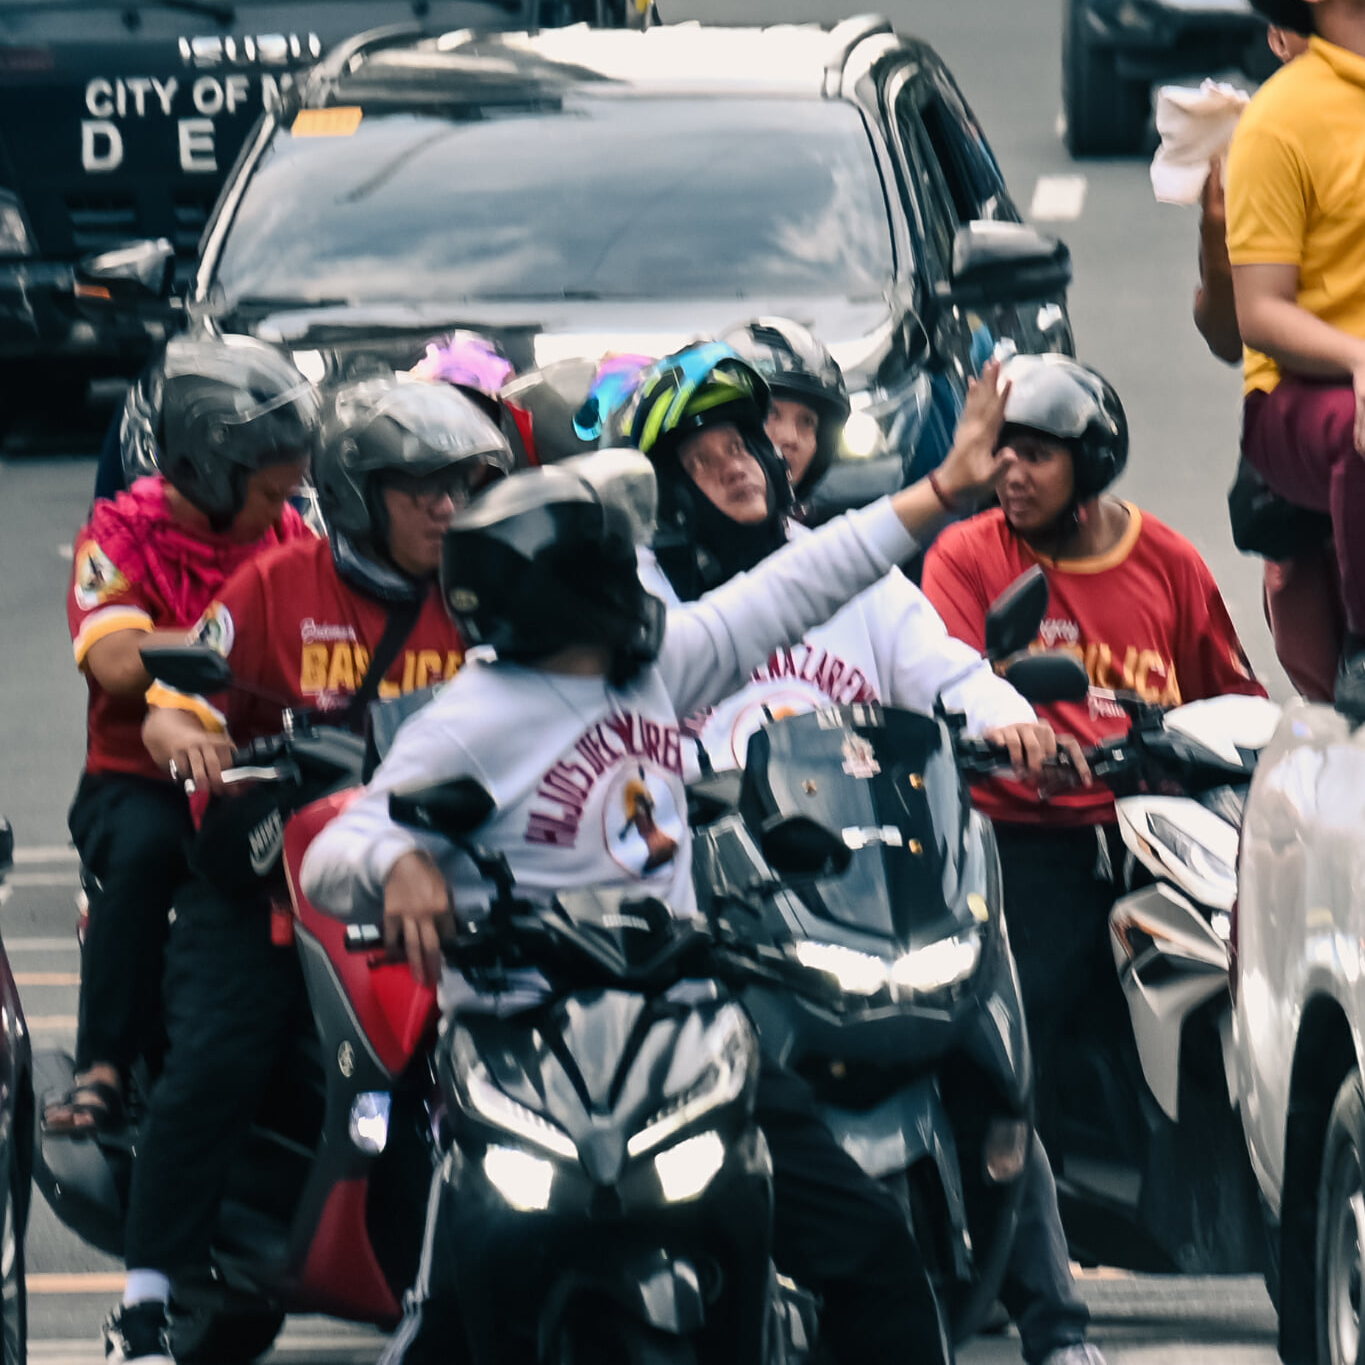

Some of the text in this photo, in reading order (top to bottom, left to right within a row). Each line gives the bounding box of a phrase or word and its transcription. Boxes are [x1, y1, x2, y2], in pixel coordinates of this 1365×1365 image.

[85, 76, 178, 117] CITY
[193, 75, 249, 115] OF
[82, 117, 217, 172] D E
